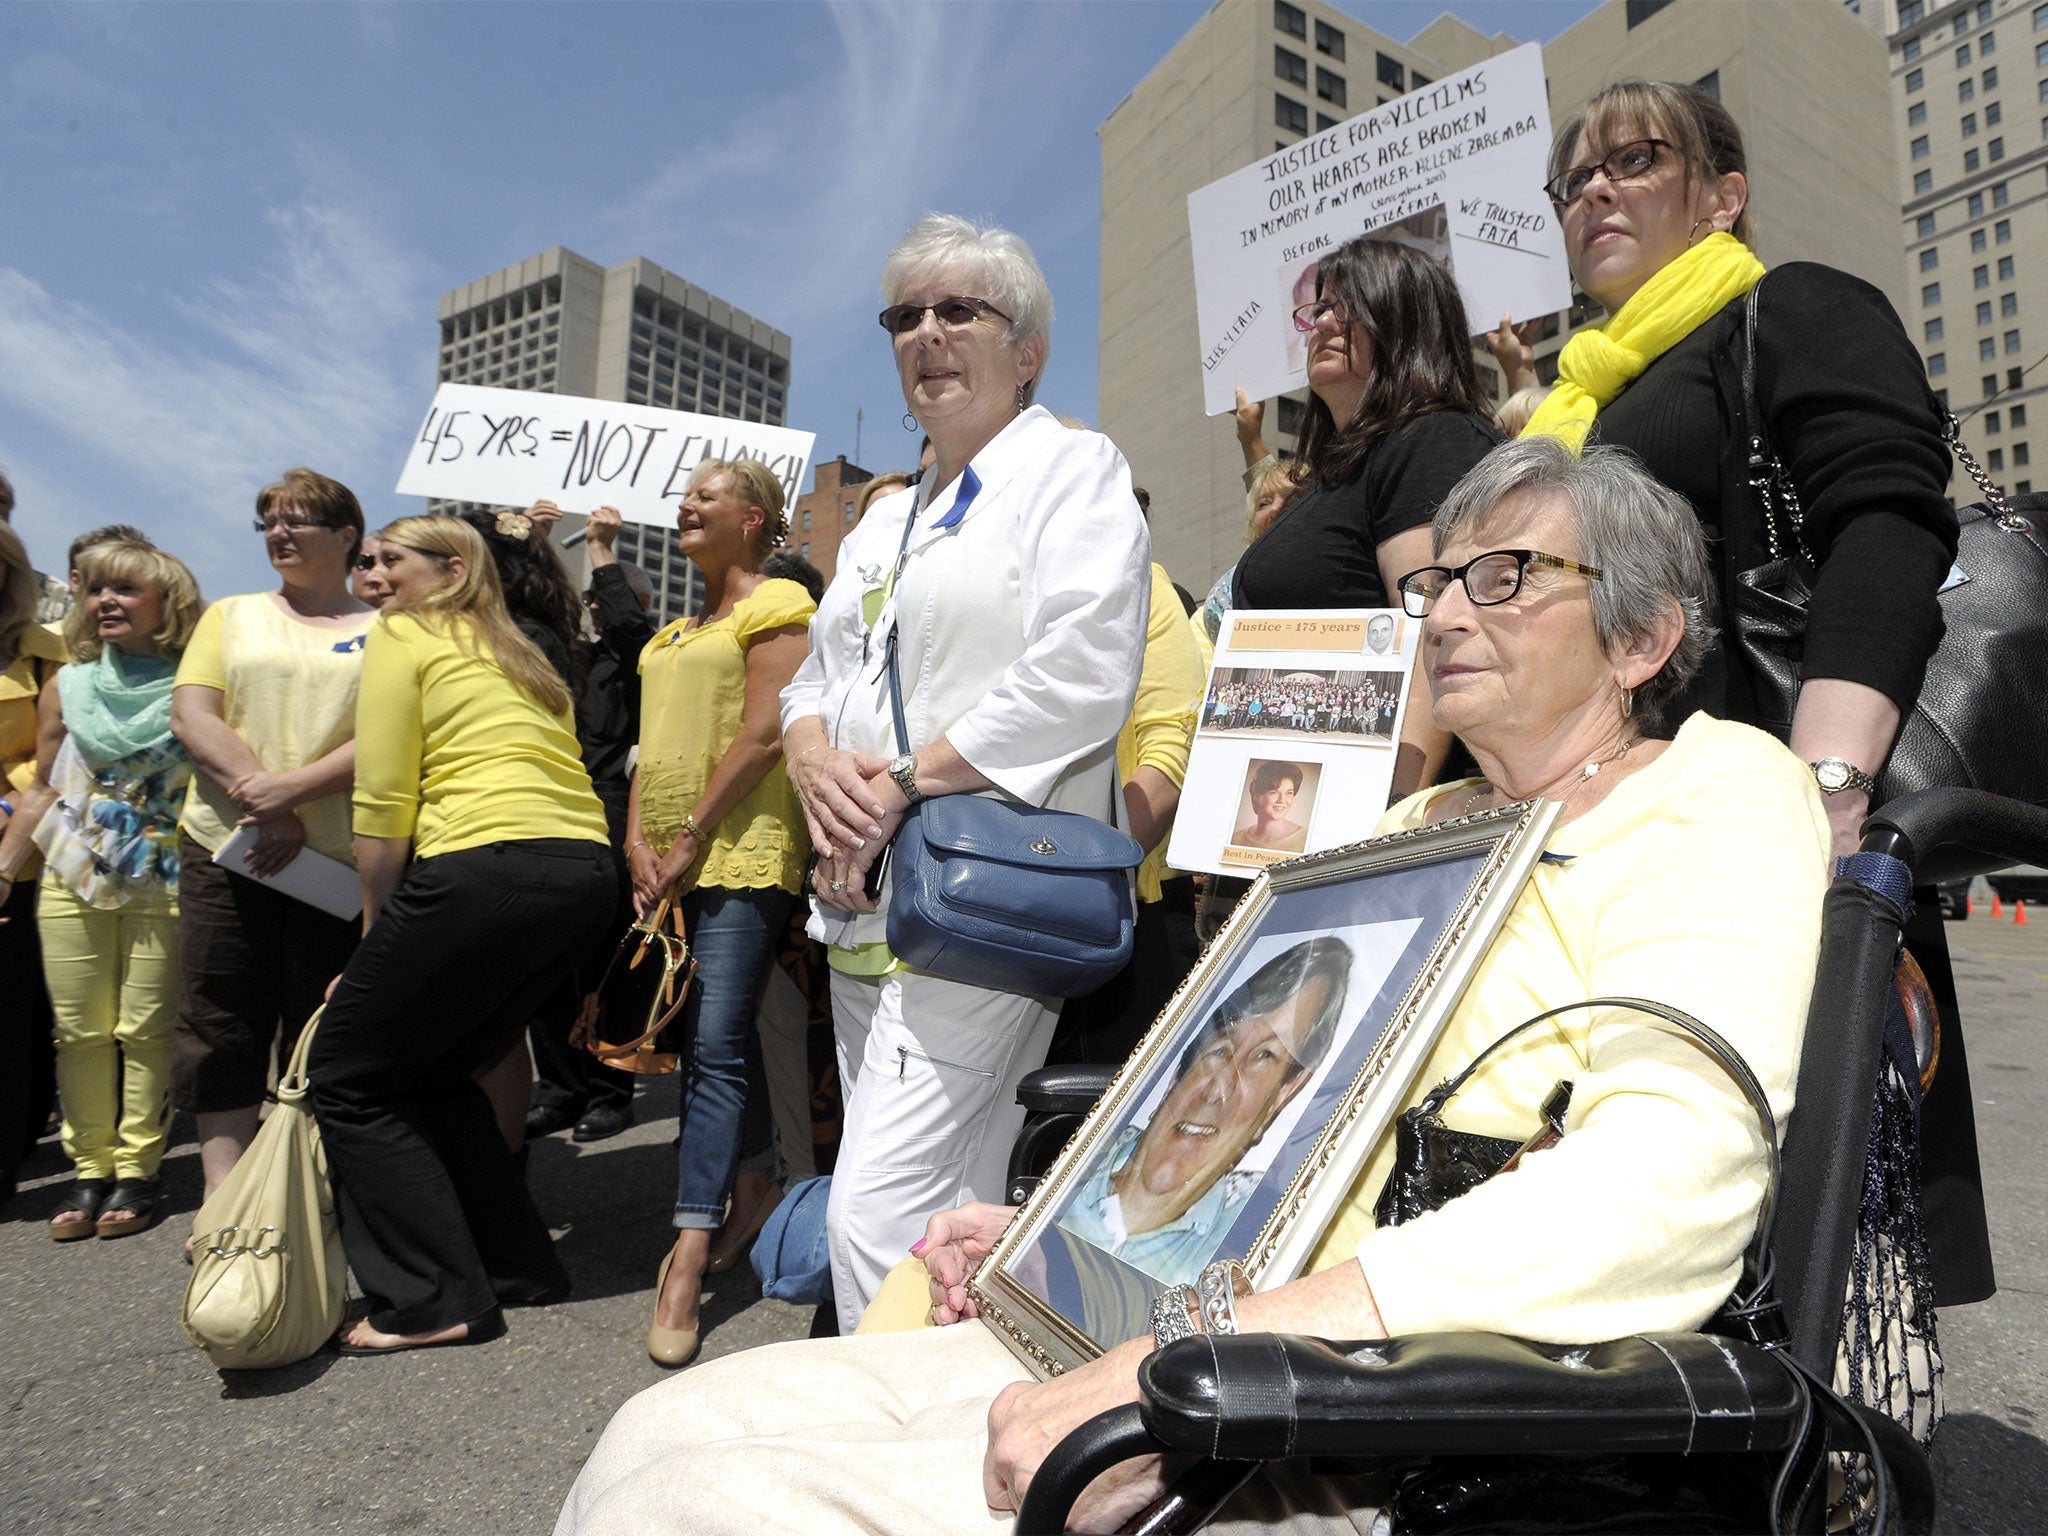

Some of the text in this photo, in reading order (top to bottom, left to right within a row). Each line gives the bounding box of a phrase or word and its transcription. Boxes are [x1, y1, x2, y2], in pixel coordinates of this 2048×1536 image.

[1262, 134, 1341, 182] JUSTICE
[1269, 106, 1487, 212] OUR HEARTS ARE BROKEN
[1240, 229, 1257, 247] IN
[1261, 207, 1309, 239] MEMORY
[1468, 116, 1537, 155] ZAREMBA
[1364, 192, 1440, 230] AFTER FATA
[1460, 196, 1481, 216] WE
[1282, 233, 1333, 262] BEFORE
[1478, 223, 1518, 246] FATA
[1232, 301, 1261, 334] FATA
[421, 408, 470, 464] 45
[562, 420, 668, 489] NOT
[1234, 622, 1282, 632] Justice
[1295, 622, 1317, 632] 175
[1320, 623, 1361, 634] years
[1223, 849, 1242, 858] Rest
